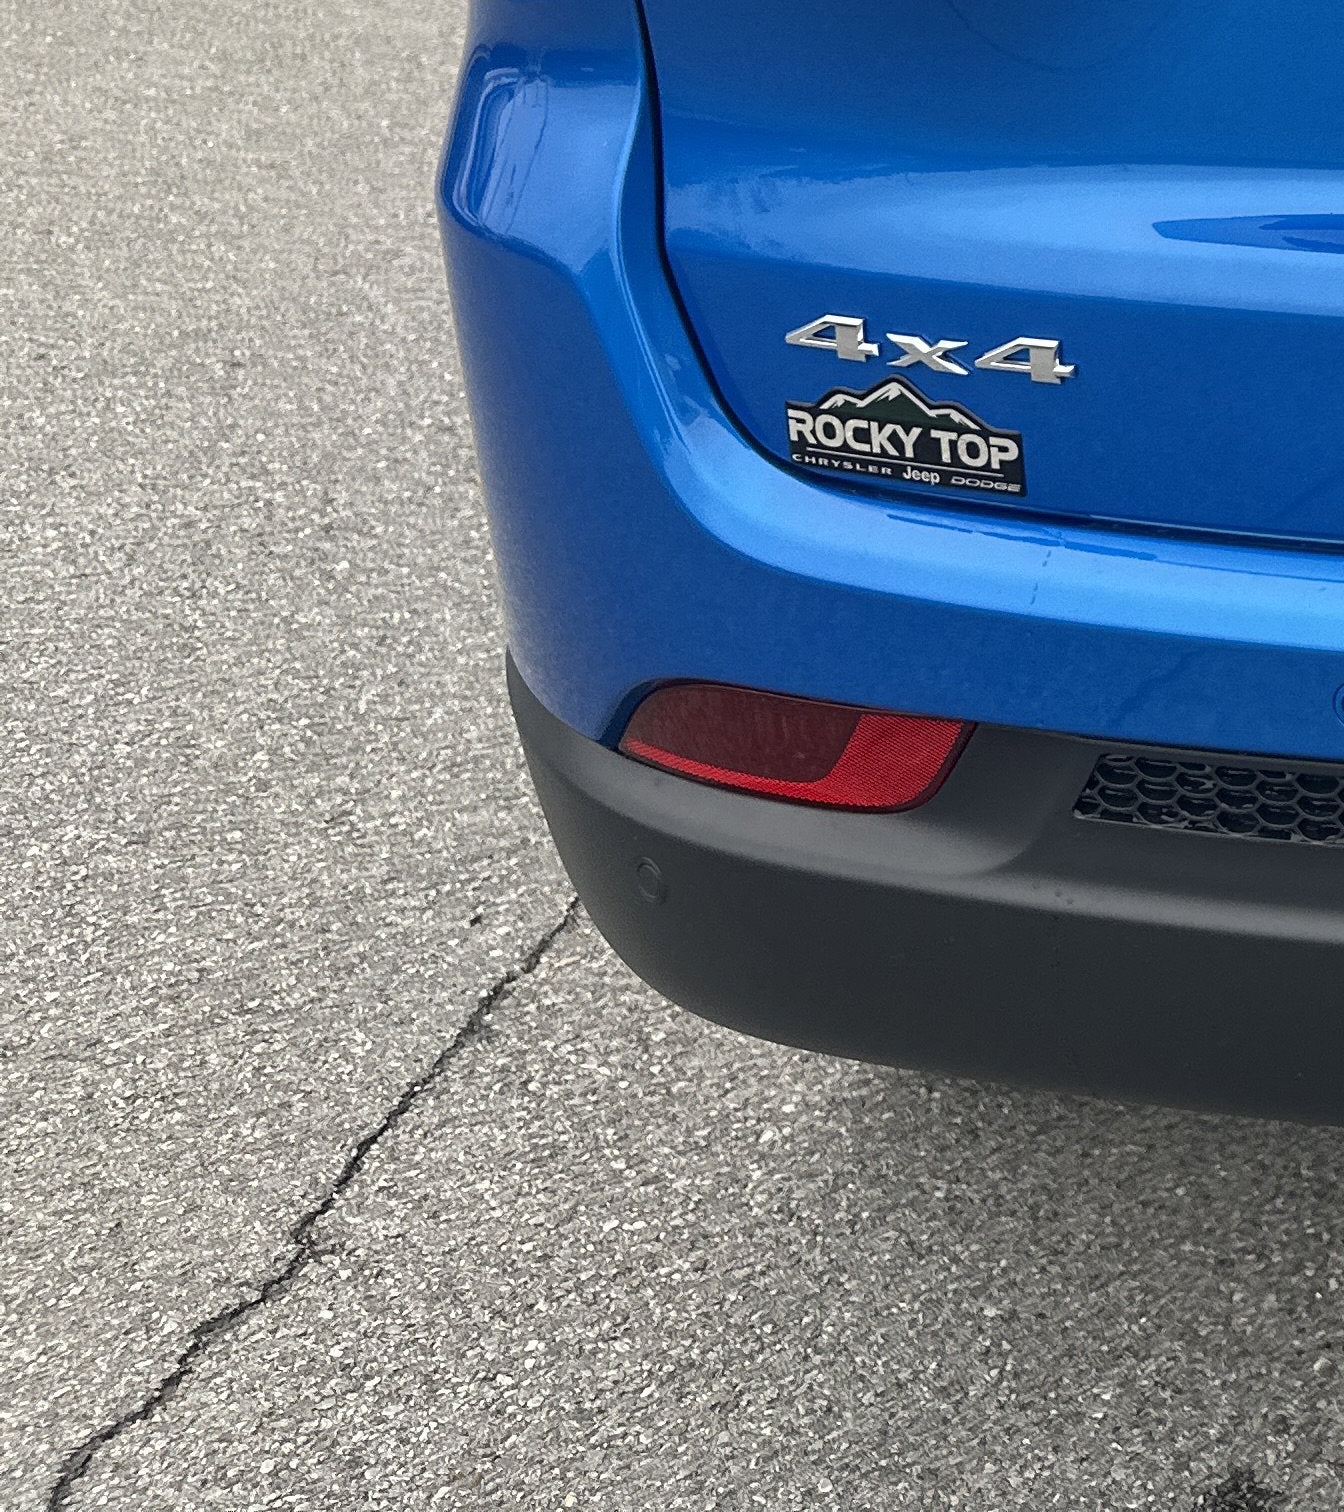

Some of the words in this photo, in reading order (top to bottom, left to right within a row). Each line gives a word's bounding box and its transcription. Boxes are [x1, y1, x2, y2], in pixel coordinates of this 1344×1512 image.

[787, 408, 923, 459] ROCKY
[930, 429, 1019, 469] TOP
[791, 453, 893, 476] CHRYSLER
[902, 466, 940, 486] Jeep
[950, 476, 1021, 493] DODGE
